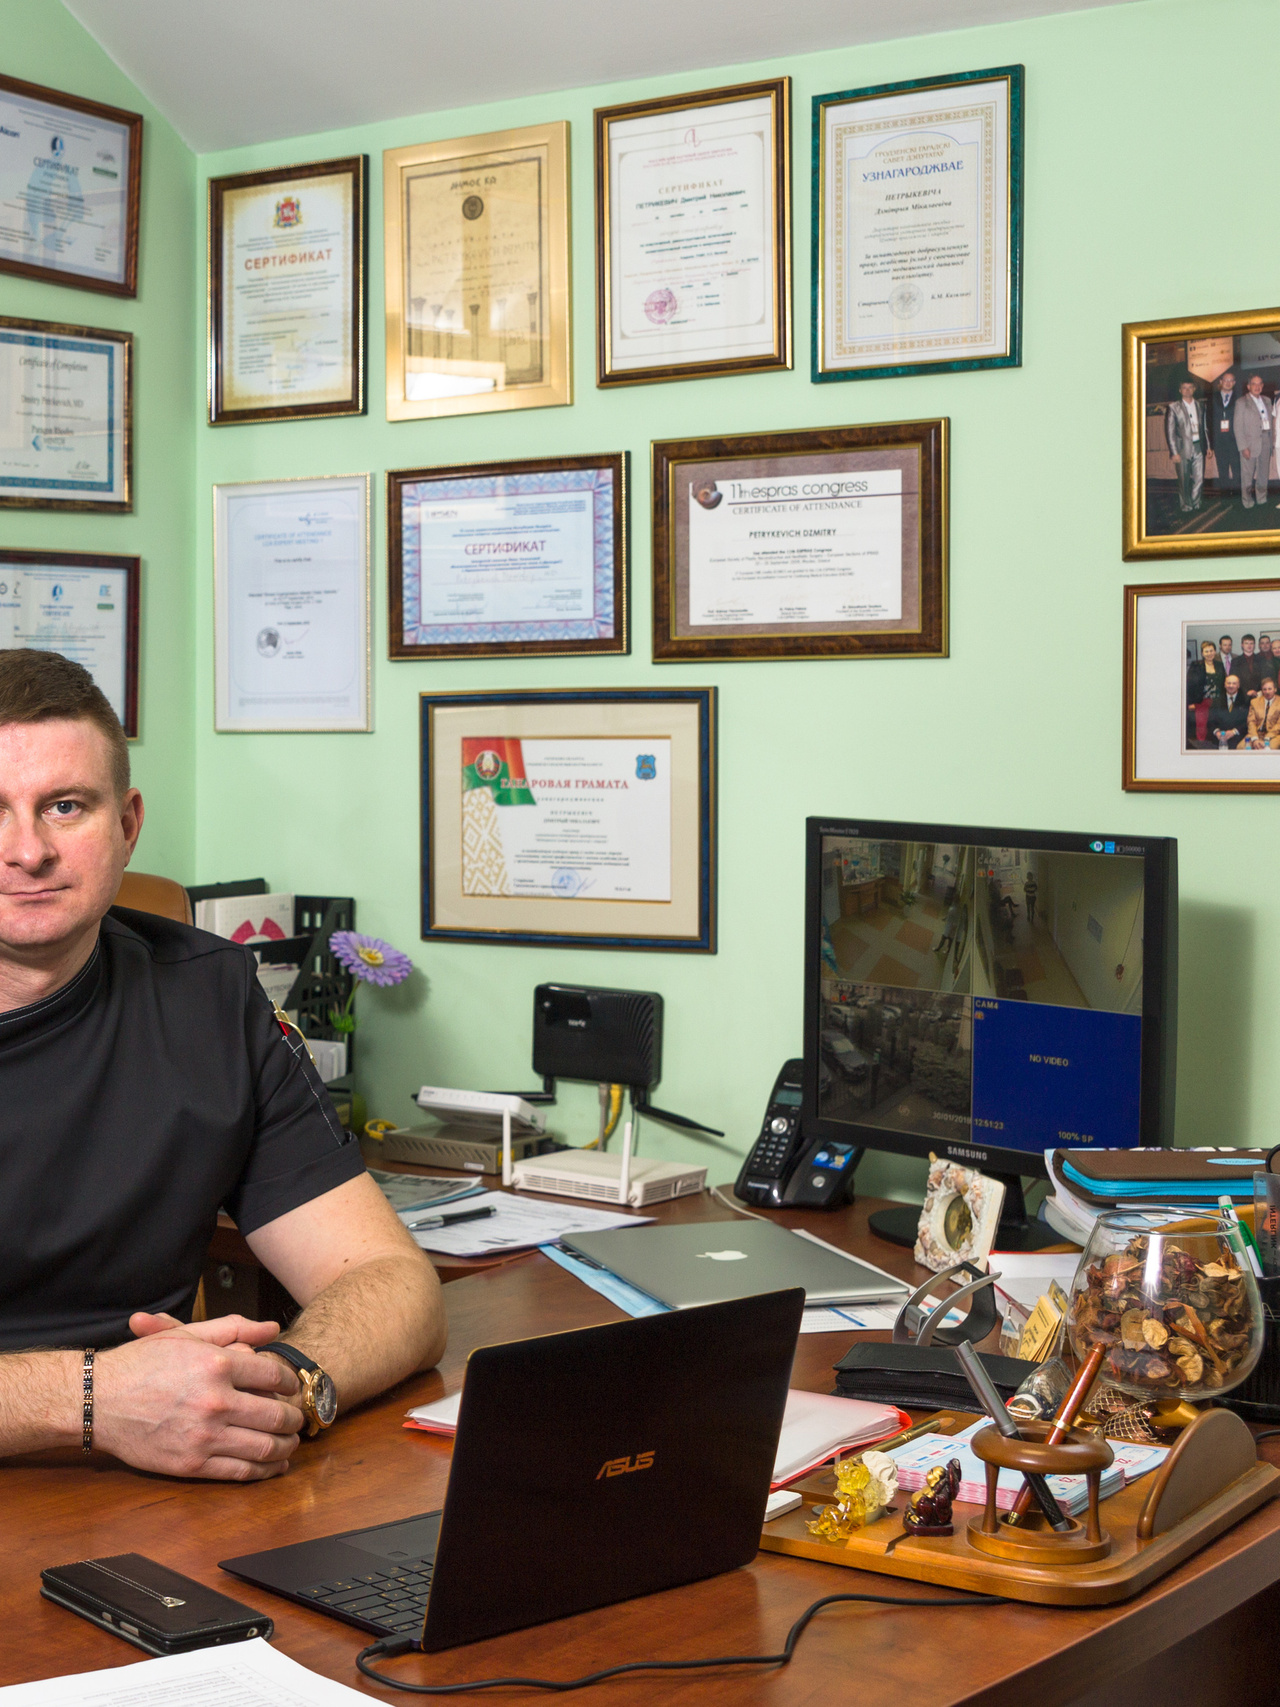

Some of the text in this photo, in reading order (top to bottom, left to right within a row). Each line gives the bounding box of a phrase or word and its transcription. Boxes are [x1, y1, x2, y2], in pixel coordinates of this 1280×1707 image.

[862, 159, 964, 183] УЗНАГАРОДЖВАЕ
[658, 179, 724, 196] СЕРТИФИКАТ
[636, 197, 678, 211] ПЕТРИКЕВИЧ
[244, 248, 333, 271] СЕРТИФИКАТ
[751, 482, 798, 499] espras
[803, 480, 868, 497] congress
[732, 500, 863, 515] CERTIFICATE OF ATTENDANCE
[749, 529, 837, 539] PETRYKEVICH DZMITRY
[464, 540, 547, 555] СЕРТИФИКАТ
[575, 779, 629, 789] ГРАМАТА
[975, 1001, 999, 1009] CAM4
[1029, 1054, 1068, 1067] NO VIDEO
[975, 1118, 1004, 1130] 12:51:23
[1058, 1131, 1094, 1143] 100% SP
[947, 1146, 987, 1161] SAMSUNG
[596, 1451, 655, 1480] ASUS
